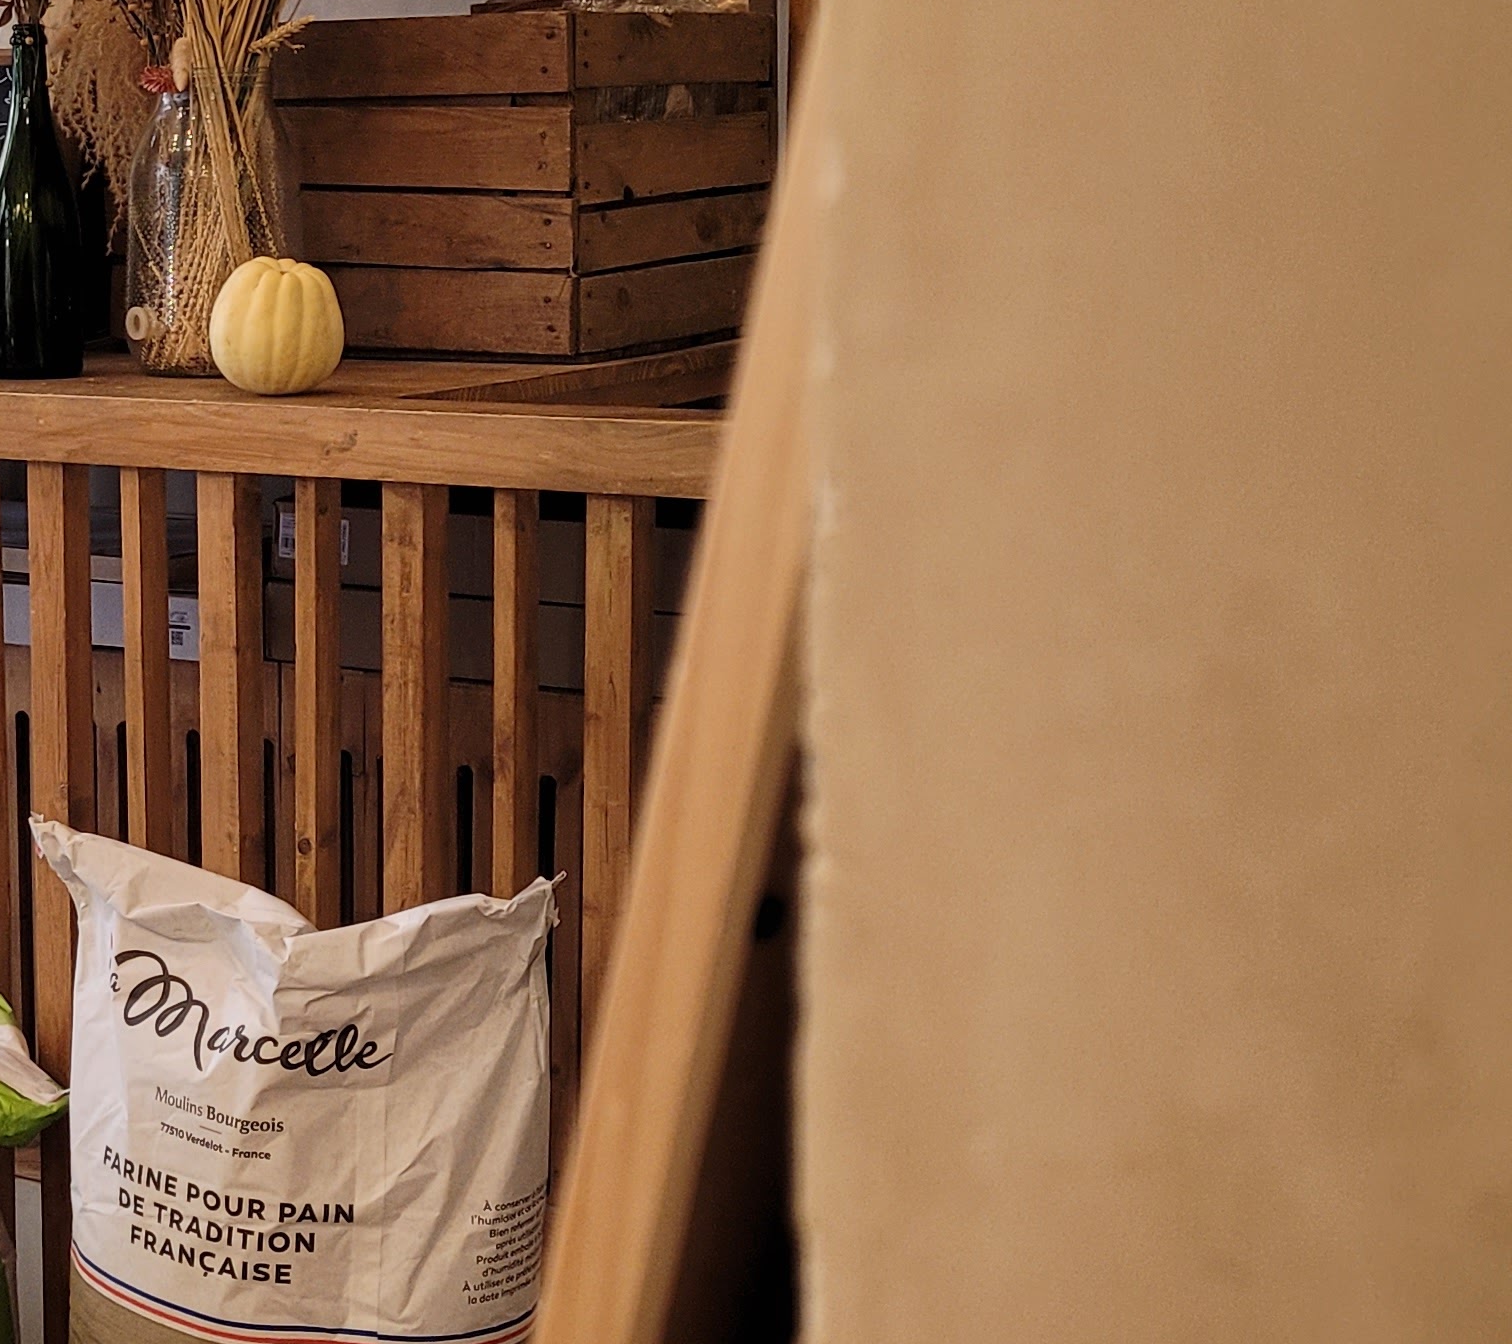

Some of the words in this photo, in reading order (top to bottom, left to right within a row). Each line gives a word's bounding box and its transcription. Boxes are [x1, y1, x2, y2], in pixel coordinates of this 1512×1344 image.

[115, 949, 394, 1077] Marcelle
[155, 1086, 203, 1117] Moulins
[206, 1105, 285, 1134] Bourgeois
[160, 1122, 185, 1140] 77510
[186, 1132, 223, 1154] Verdelot
[231, 1147, 271, 1160] France
[103, 1145, 178, 1198] FARINE
[186, 1182, 266, 1221] POUR
[278, 1202, 355, 1224] PAIN
[118, 1187, 145, 1218] DE
[153, 1201, 316, 1254] TRADITION
[130, 1224, 293, 1285] FRANÇAISE
